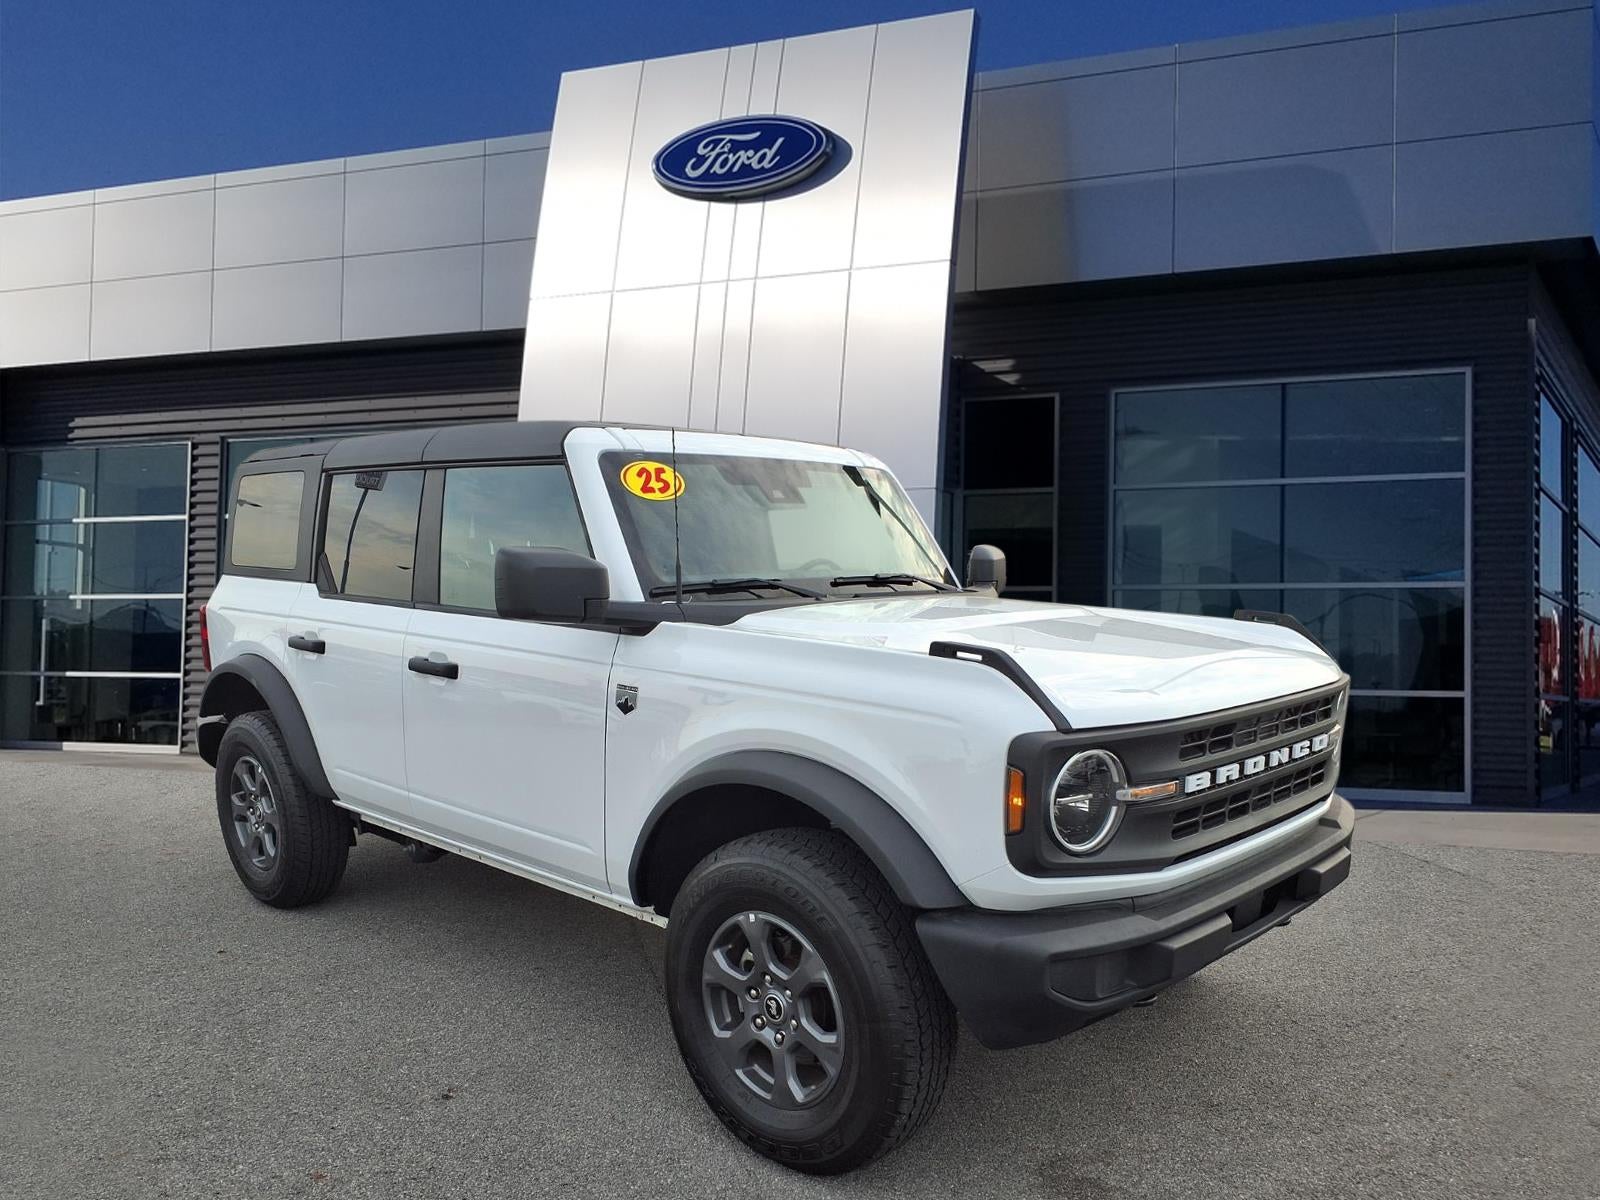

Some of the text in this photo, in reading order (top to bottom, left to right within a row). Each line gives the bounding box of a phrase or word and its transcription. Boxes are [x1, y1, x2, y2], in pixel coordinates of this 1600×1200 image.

[685, 131, 785, 178] Ford
[636, 466, 671, 494] 25
[1184, 733, 1329, 793] BRONCO
